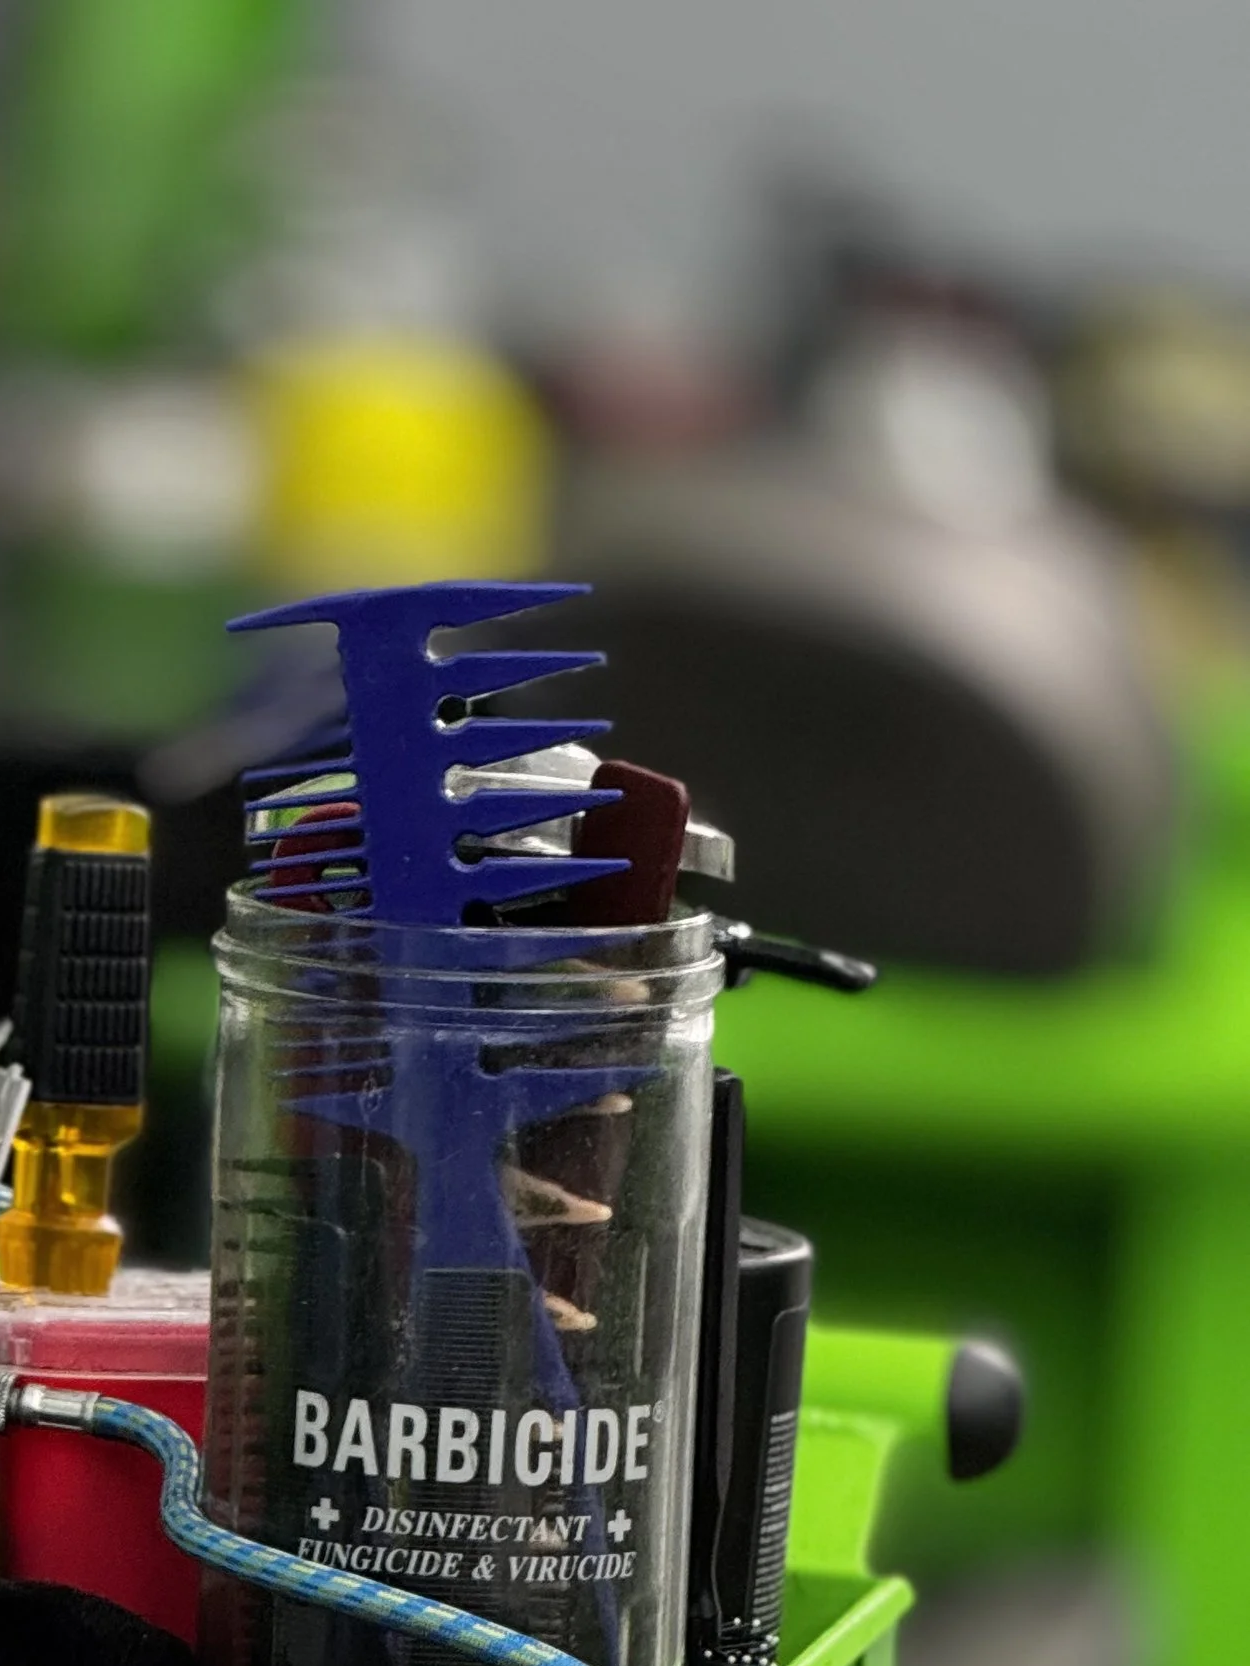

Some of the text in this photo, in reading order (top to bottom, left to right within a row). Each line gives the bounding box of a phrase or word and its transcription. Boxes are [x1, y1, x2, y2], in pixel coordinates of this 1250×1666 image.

[293, 1389, 651, 1487] BARBICIDE
[360, 1506, 592, 1543] DISINFECTANT
[298, 1537, 638, 1582] FUNGICIDE & VIRUCIDE
